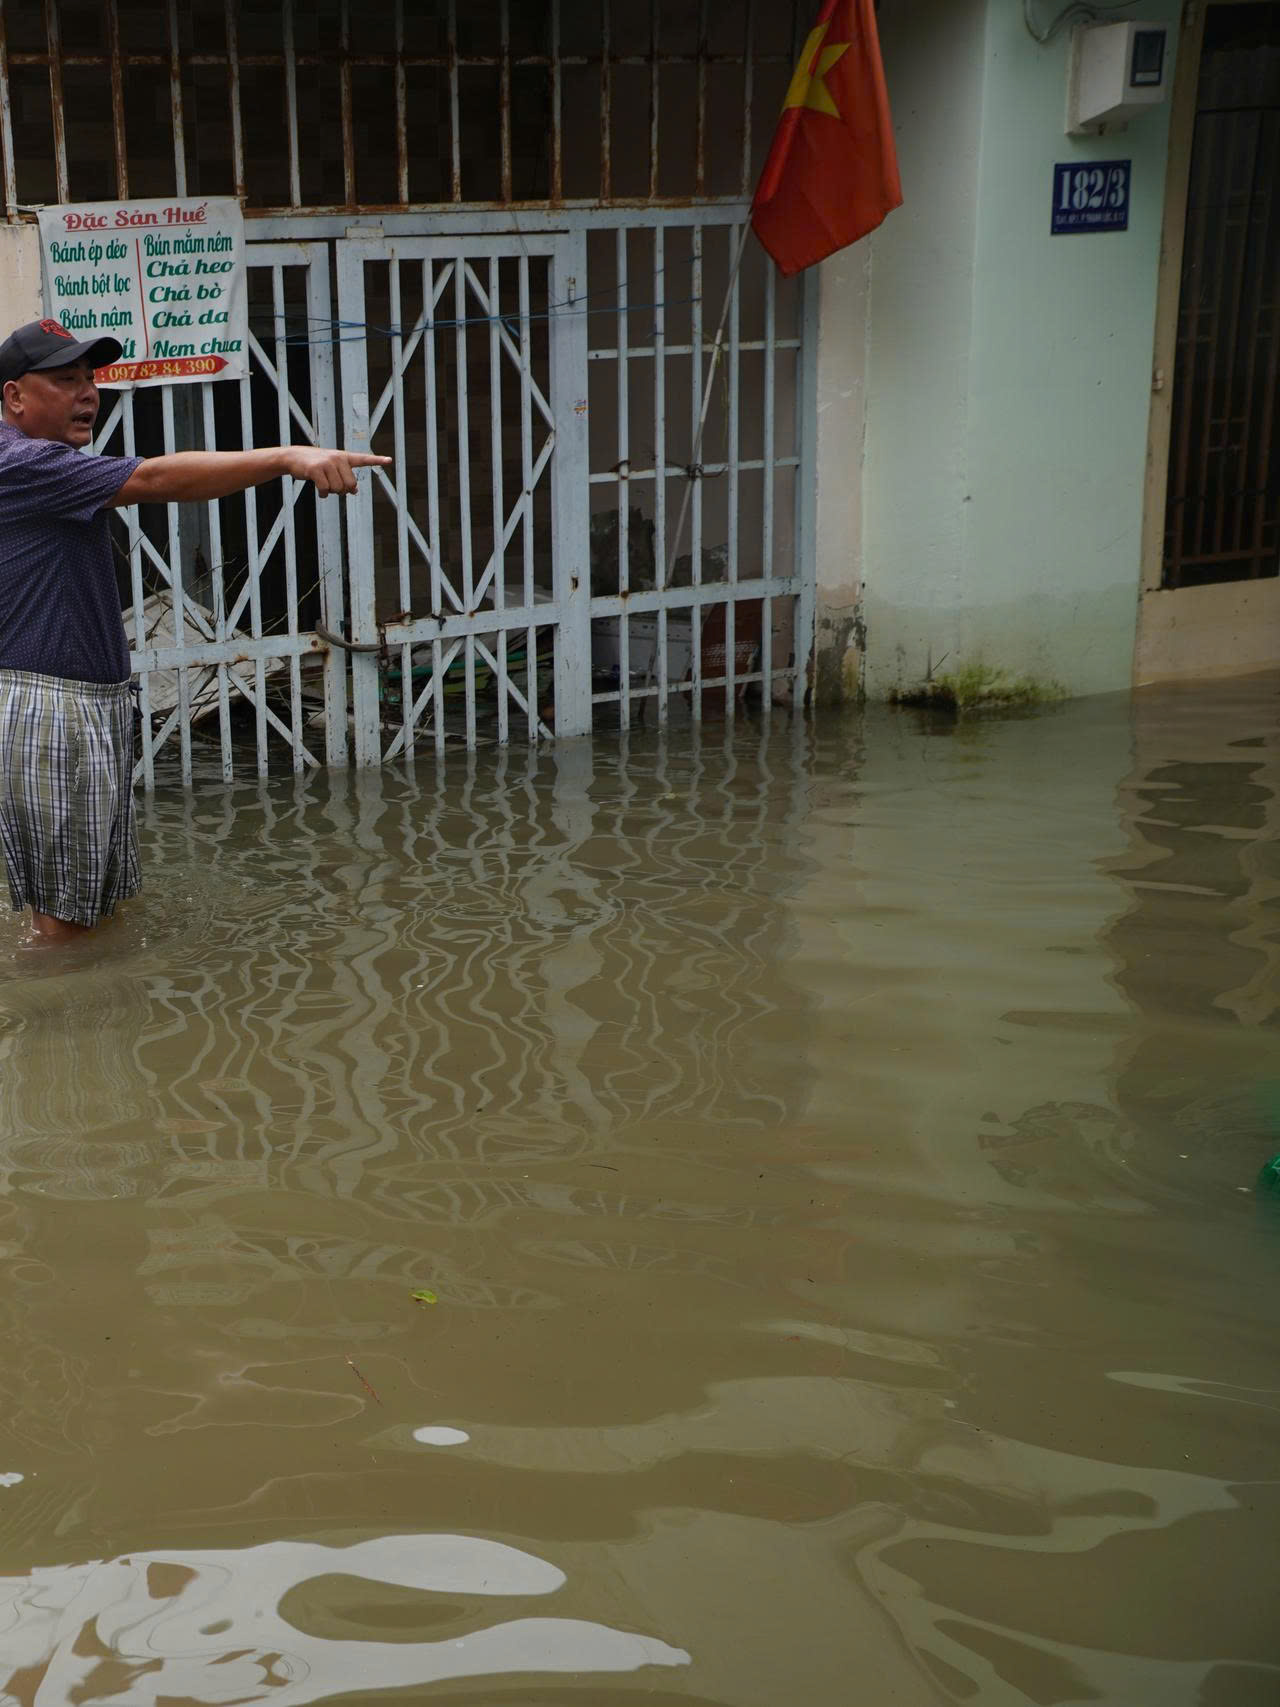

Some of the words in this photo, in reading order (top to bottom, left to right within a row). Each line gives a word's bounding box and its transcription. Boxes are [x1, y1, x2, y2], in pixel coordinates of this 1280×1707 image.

[1059, 167, 1126, 210] 182/3
[62, 212, 108, 231] Đặc
[114, 209, 159, 227] Sản
[163, 202, 208, 224] Huế
[50, 241, 87, 264] Bánh
[88, 239, 103, 268] ép
[106, 238, 129, 260] dẻo
[144, 233, 171, 257] Bún
[173, 228, 205, 255] mắm
[207, 230, 234, 253] nêm
[146, 259, 192, 278] Chả
[195, 259, 236, 275] heo
[54, 274, 90, 297] Bánh
[92, 272, 111, 298] bột
[114, 272, 132, 296] lọc
[149, 284, 193, 304] Chả
[196, 282, 226, 300] bò
[59, 307, 98, 330] Bánh
[100, 305, 134, 332] nậm
[152, 309, 194, 329] Chả
[198, 309, 229, 325] da
[152, 339, 196, 358] Nem
[162, 361, 181, 376] 84
[185, 358, 217, 374] 390
